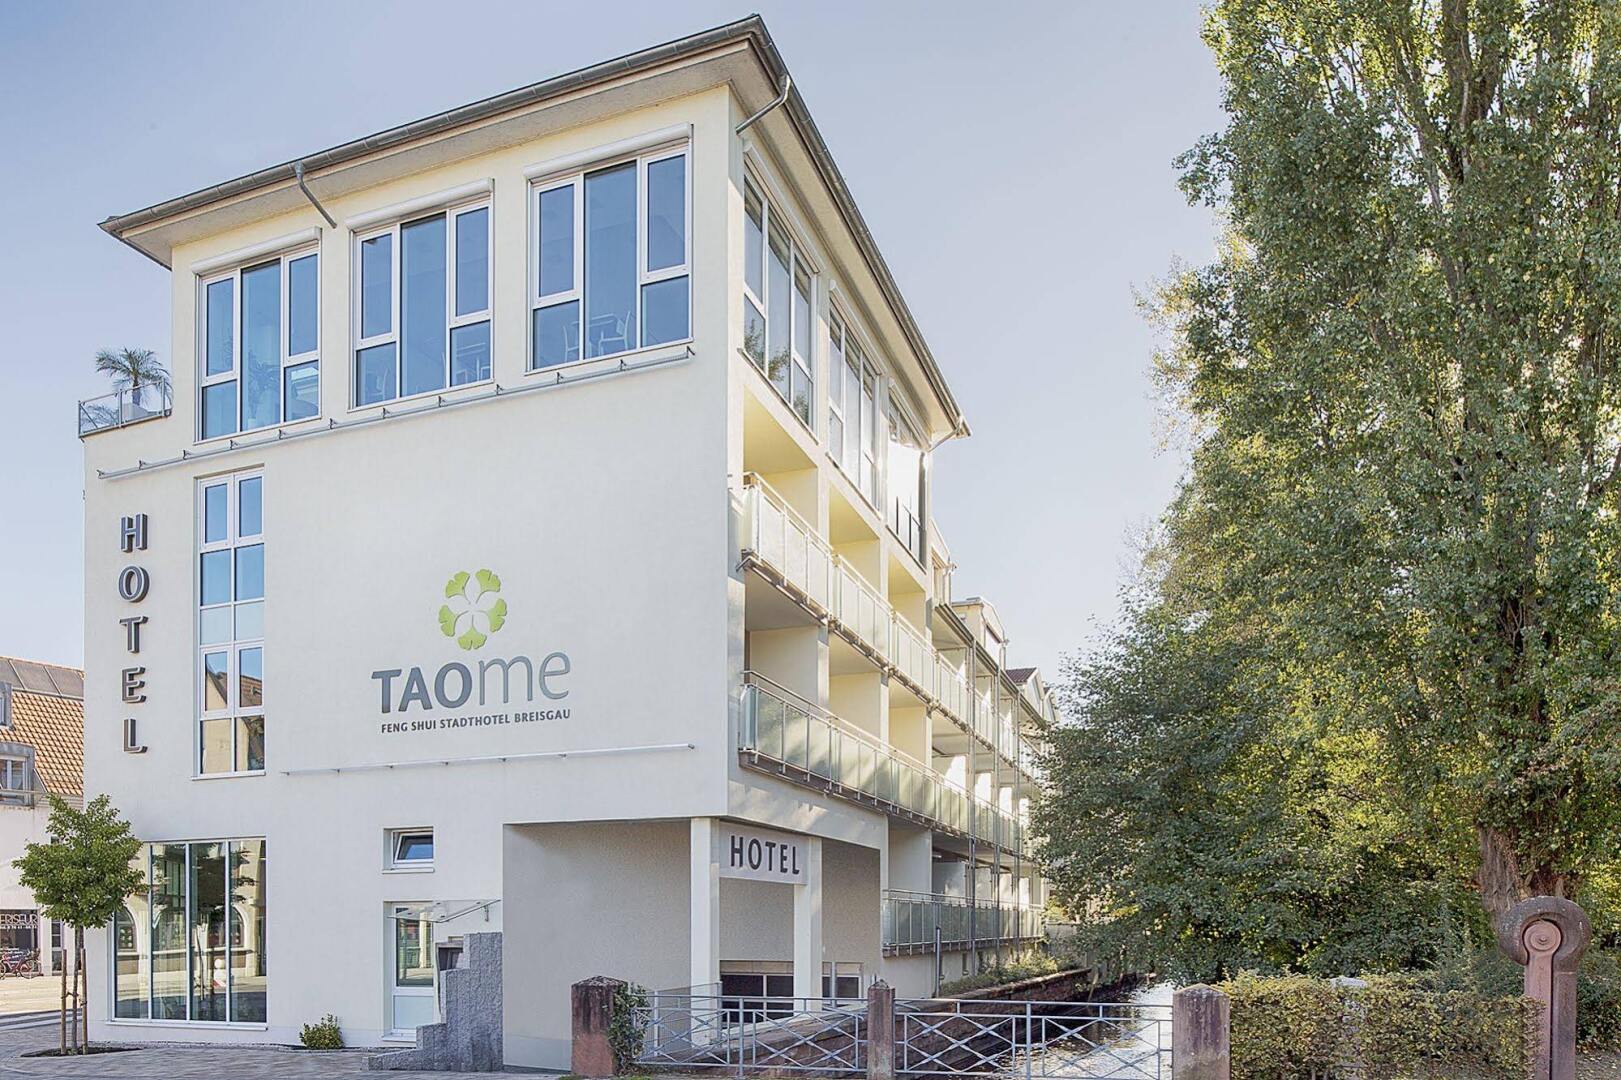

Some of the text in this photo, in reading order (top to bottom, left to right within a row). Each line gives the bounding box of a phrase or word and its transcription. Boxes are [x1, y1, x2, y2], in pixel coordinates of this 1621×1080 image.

[119, 513, 150, 754] HOTEL
[371, 651, 571, 714] TAOme
[381, 709, 571, 733] FENG SHUI STADTHOTEL BREISGAU
[730, 835, 800, 875] HOTEL
